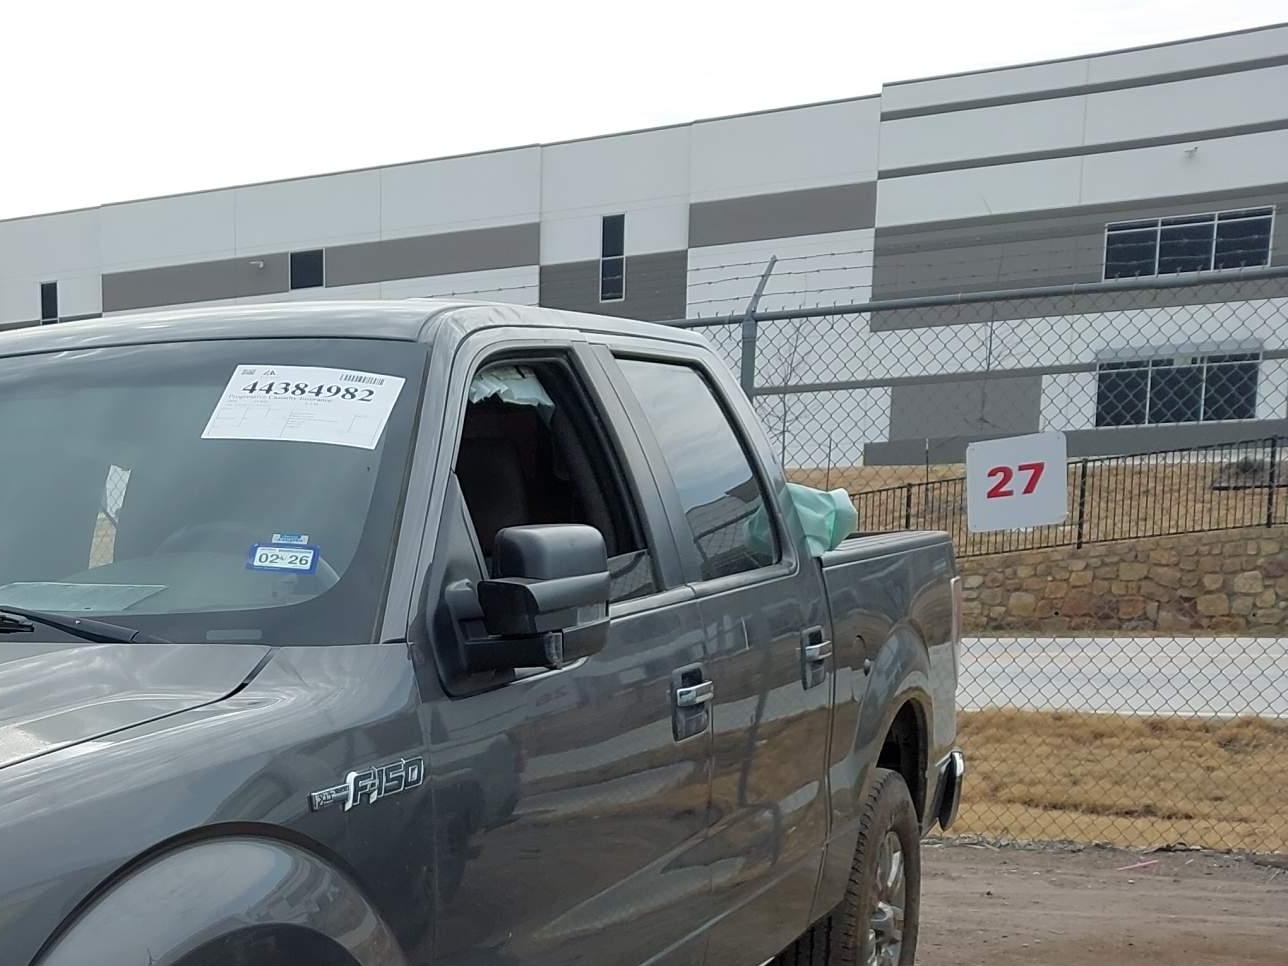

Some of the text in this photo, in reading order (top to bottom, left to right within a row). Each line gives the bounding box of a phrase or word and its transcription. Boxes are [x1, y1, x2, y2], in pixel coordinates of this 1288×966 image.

[242, 380, 375, 402] 44384982
[987, 462, 1045, 498] 27
[258, 552, 310, 565] 02 26
